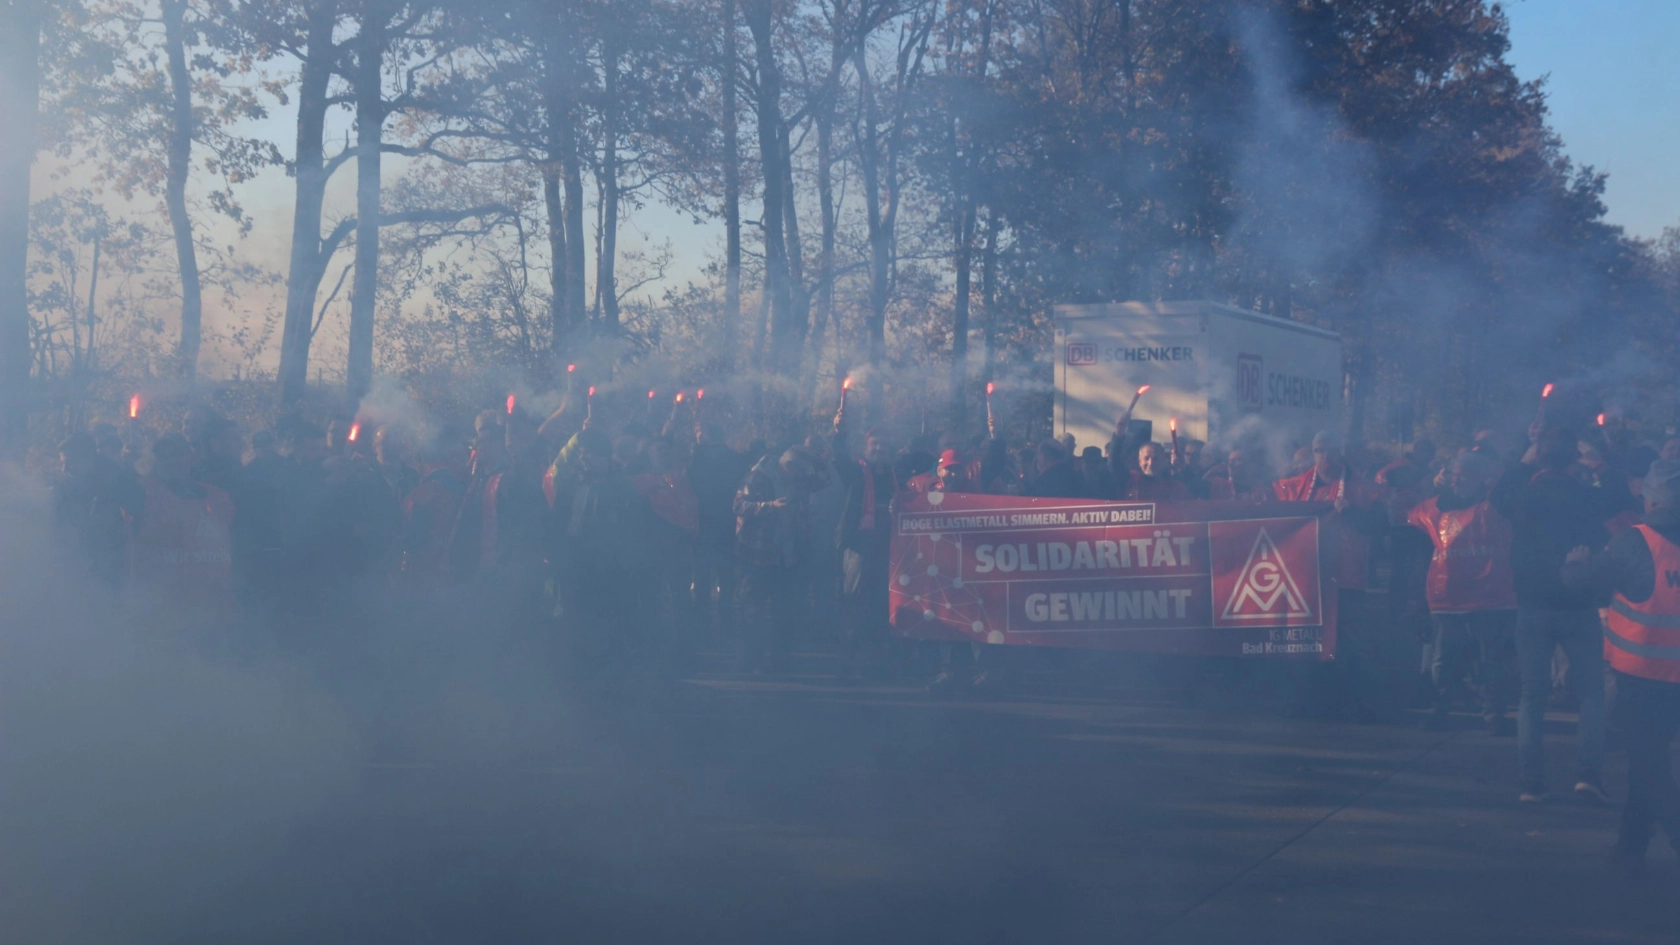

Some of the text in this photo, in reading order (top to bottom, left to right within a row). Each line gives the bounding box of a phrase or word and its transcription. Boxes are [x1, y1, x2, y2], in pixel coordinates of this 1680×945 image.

[1070, 346, 1194, 362] DB SCHENKER
[1240, 362, 1330, 410] DB SCHENKER
[902, 508, 1152, 530] BOGE ELASTMETALL SIMMERN. AKTIV DABEI!
[974, 529, 1196, 573] SOLIDARITÄT
[1024, 588, 1192, 622] GEWINNT
[1269, 628, 1322, 640] IG METALL
[1242, 641, 1322, 654] Bad Kreuznach
